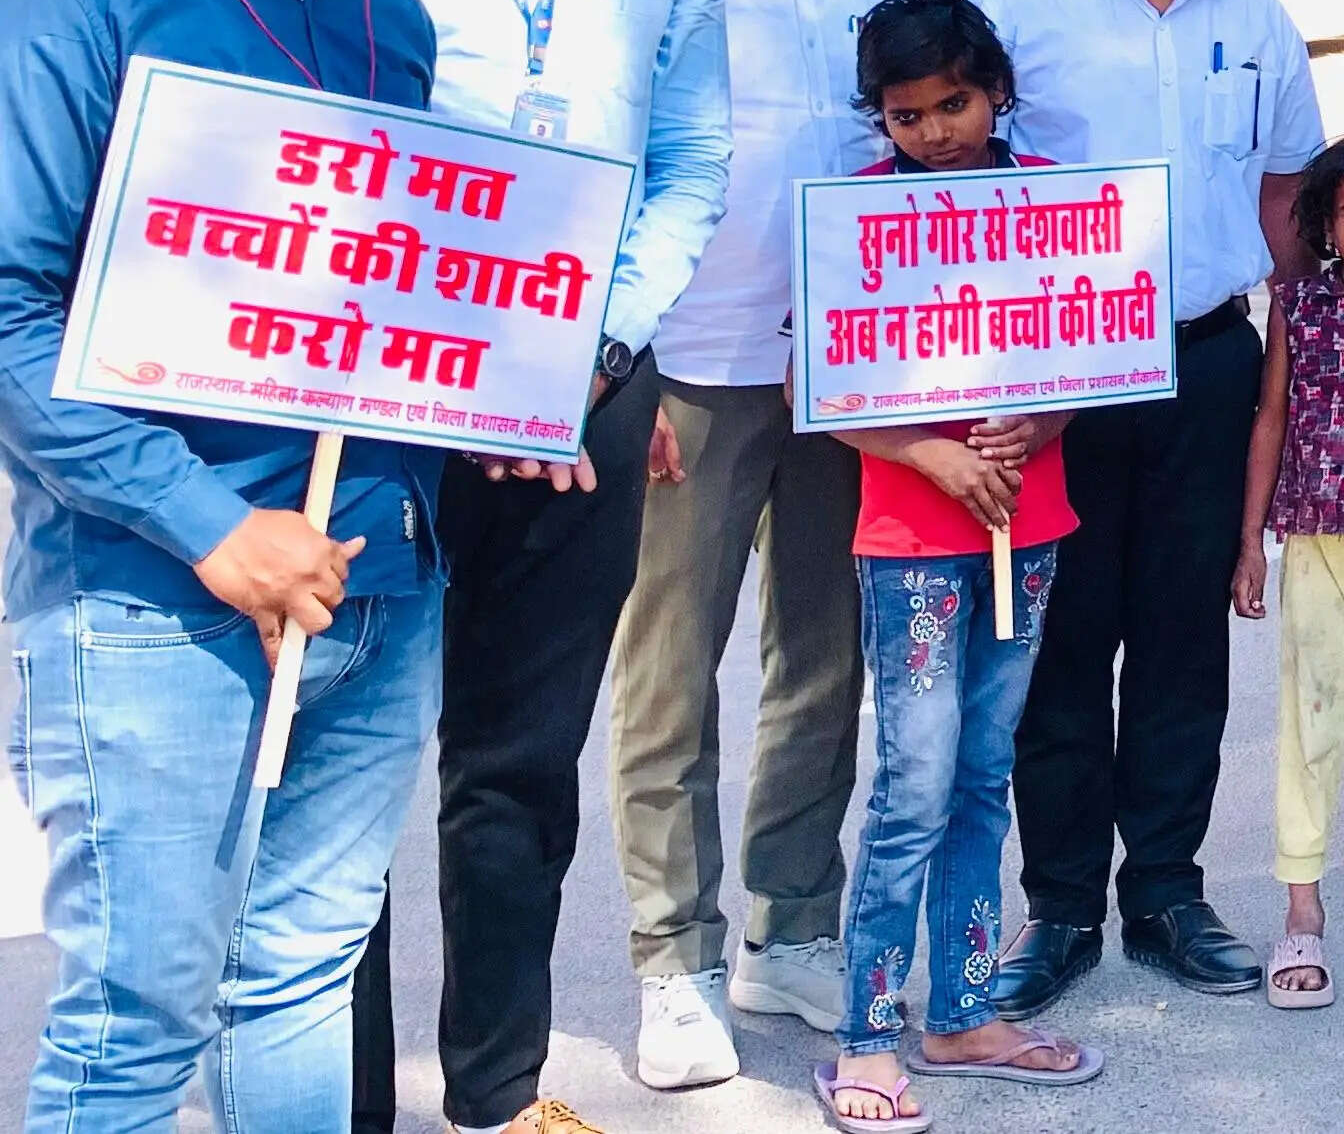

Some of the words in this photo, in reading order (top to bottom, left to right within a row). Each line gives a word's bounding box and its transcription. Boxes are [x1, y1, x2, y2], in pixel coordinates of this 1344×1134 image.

[275, 129, 399, 201] डरो
[408, 154, 517, 221] मत
[145, 197, 327, 275] बच्चों
[330, 221, 431, 294] की
[435, 251, 593, 322] शादी
[858, 193, 921, 293] सुनो
[926, 190, 976, 265] गौर
[983, 188, 1009, 262] से
[1015, 183, 1123, 259] देशवासी
[228, 301, 373, 373] करो
[380, 324, 491, 391] मत
[826, 307, 879, 366] अब
[884, 305, 909, 361] न
[914, 284, 982, 359] होगी
[987, 275, 1055, 353] बच्चों
[1058, 275, 1097, 347] की
